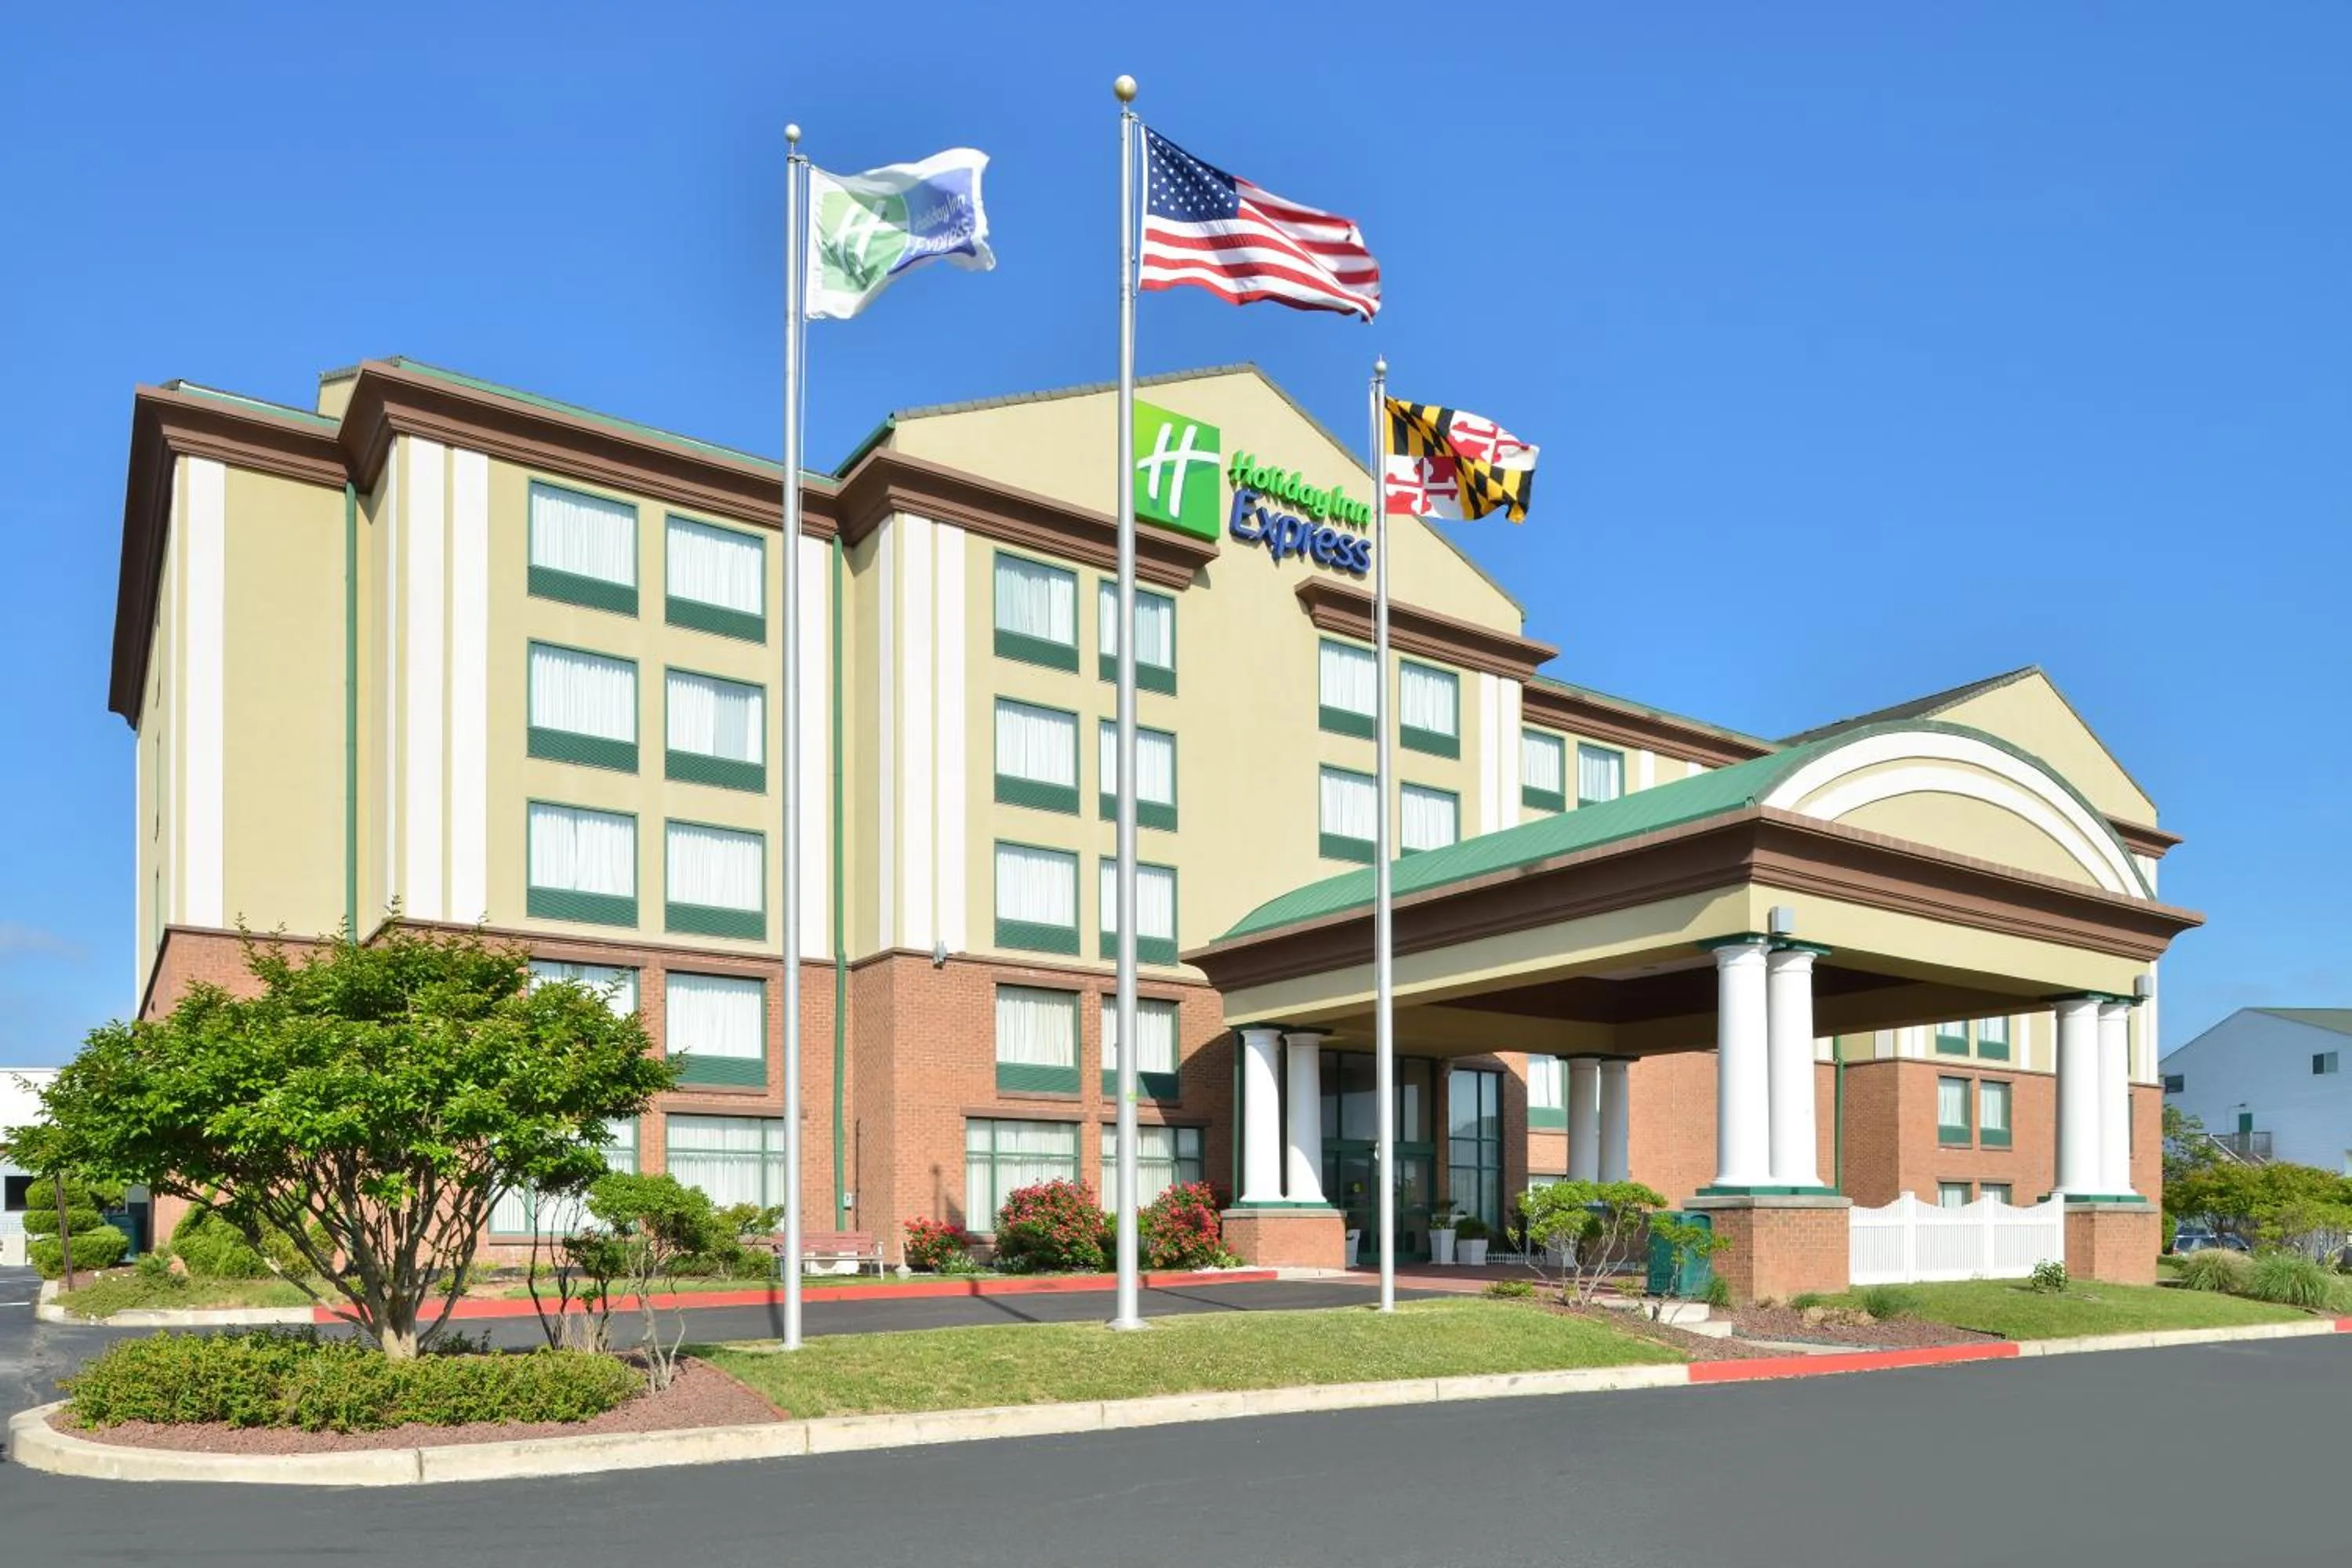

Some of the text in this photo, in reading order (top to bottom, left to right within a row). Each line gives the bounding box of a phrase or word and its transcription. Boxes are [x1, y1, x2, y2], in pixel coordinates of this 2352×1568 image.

[1137, 422, 1221, 518] H
[1229, 450, 1371, 525] Holiday Inn
[1229, 488, 1372, 574] Express
